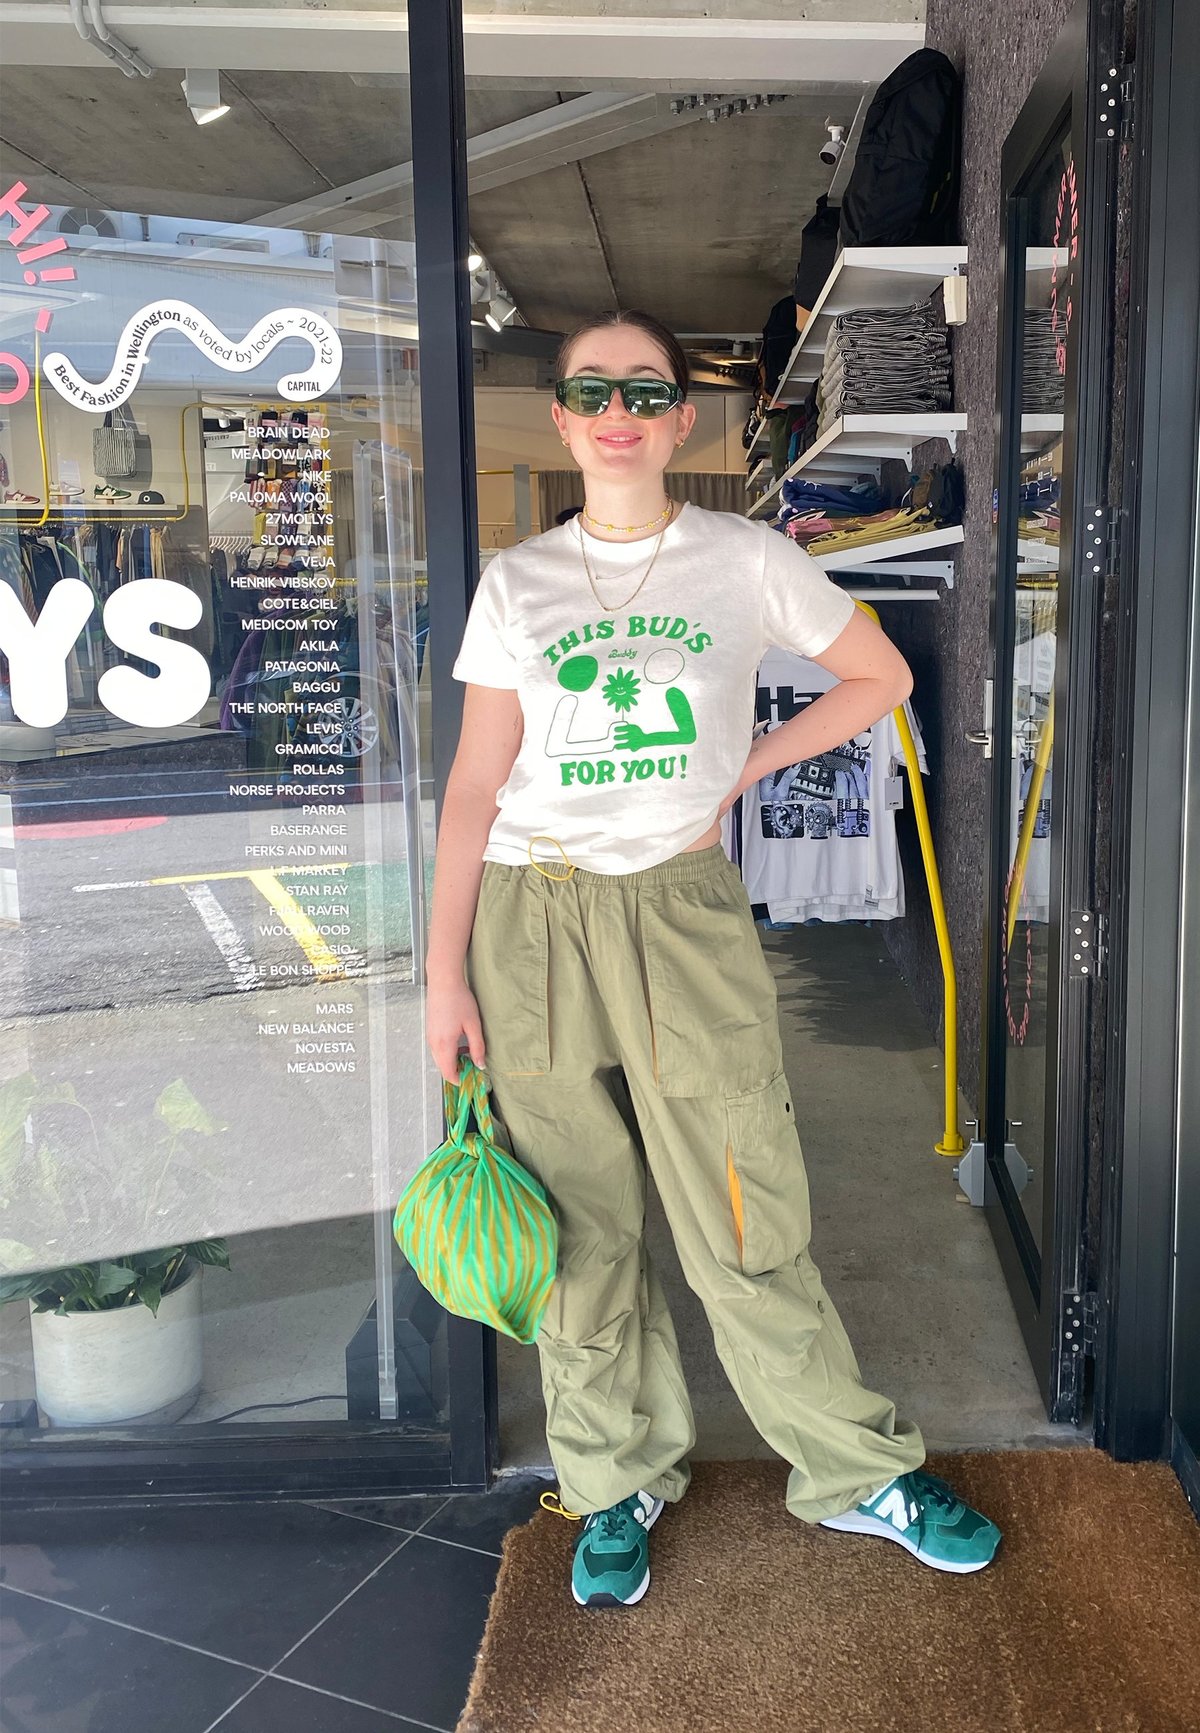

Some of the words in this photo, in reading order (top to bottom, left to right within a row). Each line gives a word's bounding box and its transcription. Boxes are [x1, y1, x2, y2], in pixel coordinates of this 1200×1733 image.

[183, 315, 199, 331] as
[126, 311, 181, 358] Wellington
[252, 320, 285, 353] locals
[199, 331, 232, 362] voted
[299, 317, 333, 365] 2021-22
[234, 350, 252, 364] by
[121, 359, 136, 378] in
[53, 364, 81, 397] Best
[287, 380, 322, 392] CAPITAL
[80, 375, 129, 406] Fashion
[248, 427, 287, 439] BRAIN
[292, 427, 330, 439] DEAD
[232, 448, 331, 460] MEADOWLARK
[303, 471, 332, 482] NIKE
[230, 491, 286, 503] PALOMA
[291, 491, 333, 504] WOOL
[266, 513, 334, 525] 27MOLLYS
[261, 534, 334, 546] SLOWLANE
[301, 556, 336, 567] VEJA
[231, 577, 276, 588] HENRIK
[281, 577, 336, 589] VIBSKOV
[263, 598, 338, 610] COTE&CIEL
[242, 619, 307, 631] MEDICOM
[313, 619, 338, 631] TOY
[300, 640, 340, 652] AKILA
[542, 619, 615, 666] THIS
[265, 660, 340, 672] PATAGONIA
[293, 682, 341, 693] BAGGU
[229, 702, 254, 714] THE
[258, 702, 304, 714] NORTH
[308, 702, 342, 714] FACE
[306, 723, 343, 734] LEVIS
[275, 744, 344, 755] GRAMICCI
[293, 764, 344, 775] ROLLAS
[560, 759, 616, 786] FOR
[229, 784, 273, 796] NORSE
[277, 784, 345, 796] PROJECTS
[302, 804, 346, 816] PARRA
[270, 824, 347, 836] BASERANGE
[245, 845, 284, 856] PERKS
[287, 845, 316, 856] AND
[319, 845, 347, 856] MINI
[286, 885, 319, 896] STAN
[323, 885, 349, 896] RAY
[259, 925, 303, 936] WOO
[252, 966, 266, 976] LE
[270, 966, 298, 976] BON
[302, 965, 354, 976] SHOPPE
[316, 1003, 353, 1014] MARS
[258, 1023, 290, 1035] NEW
[293, 1023, 354, 1034] BALANCE
[296, 1043, 355, 1054] NOVESTA
[287, 1062, 356, 1073] MEADOWS
